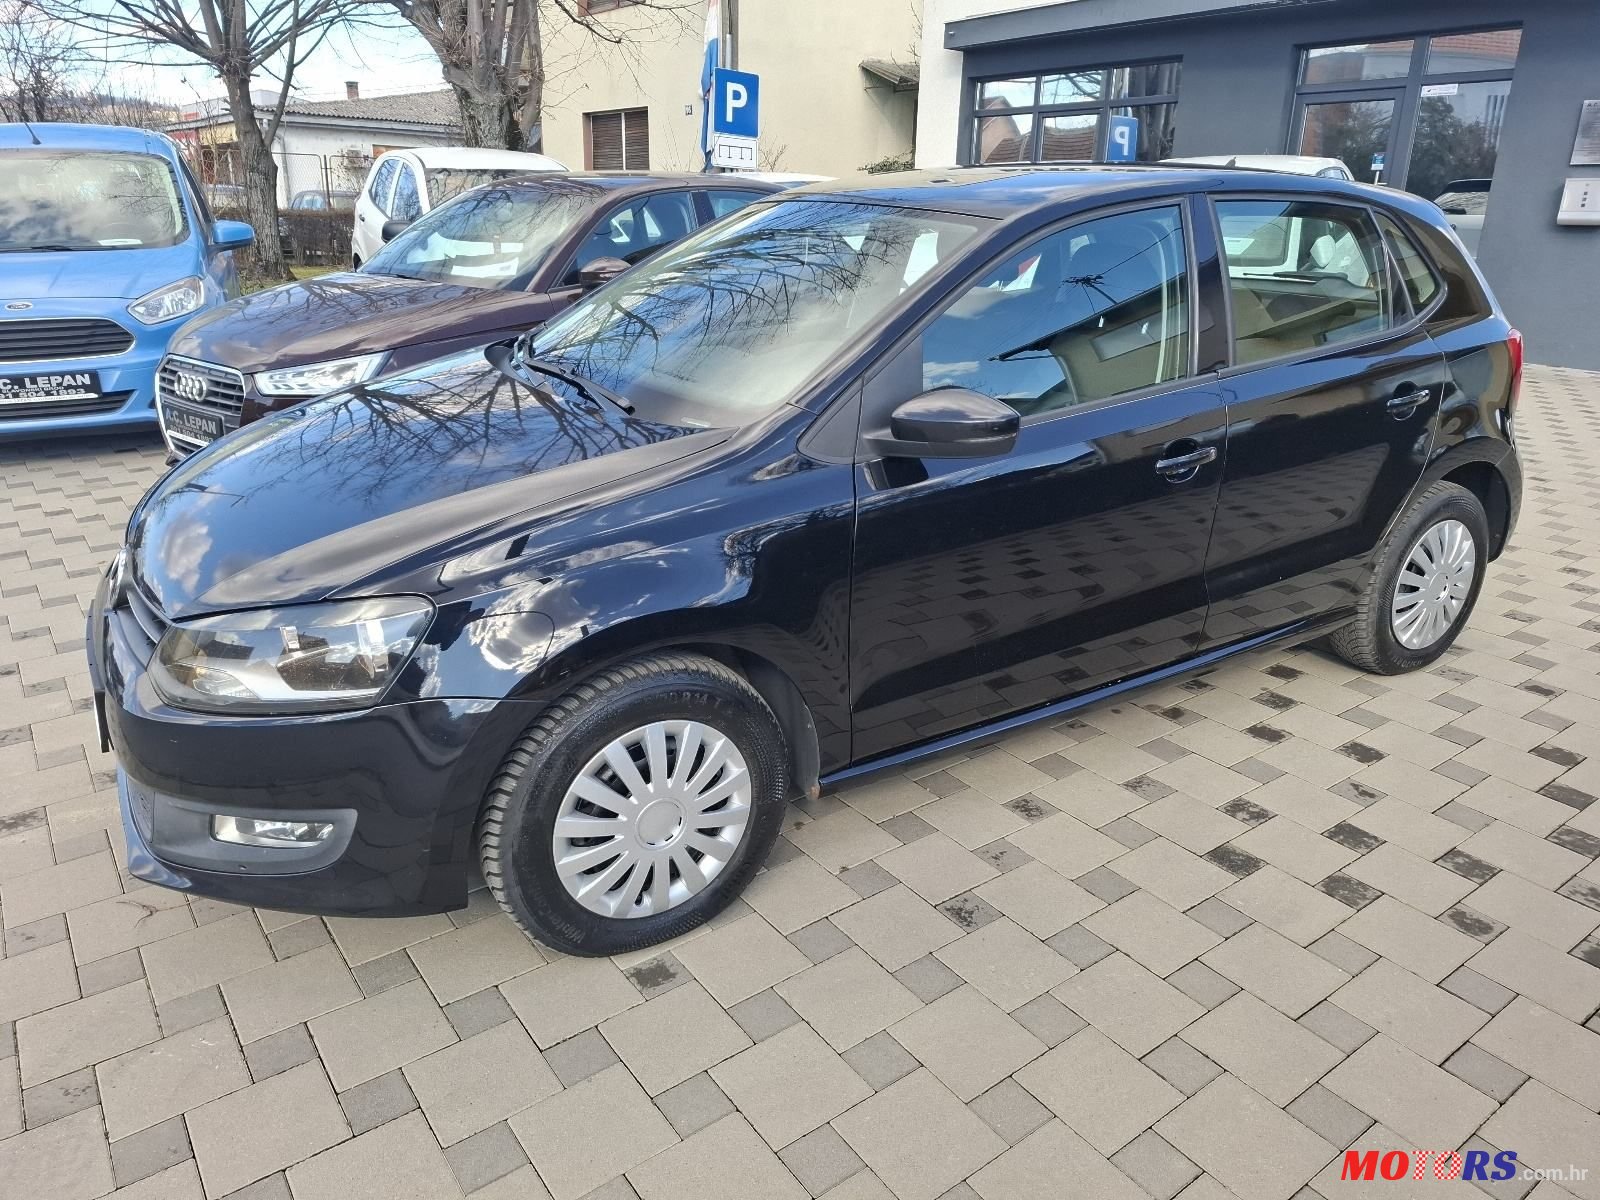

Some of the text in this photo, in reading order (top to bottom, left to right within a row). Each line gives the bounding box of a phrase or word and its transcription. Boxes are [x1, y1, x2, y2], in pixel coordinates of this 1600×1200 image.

[726, 81, 748, 123] P
[24, 373, 91, 389] LEPAN
[183, 413, 217, 435] LEPAN
